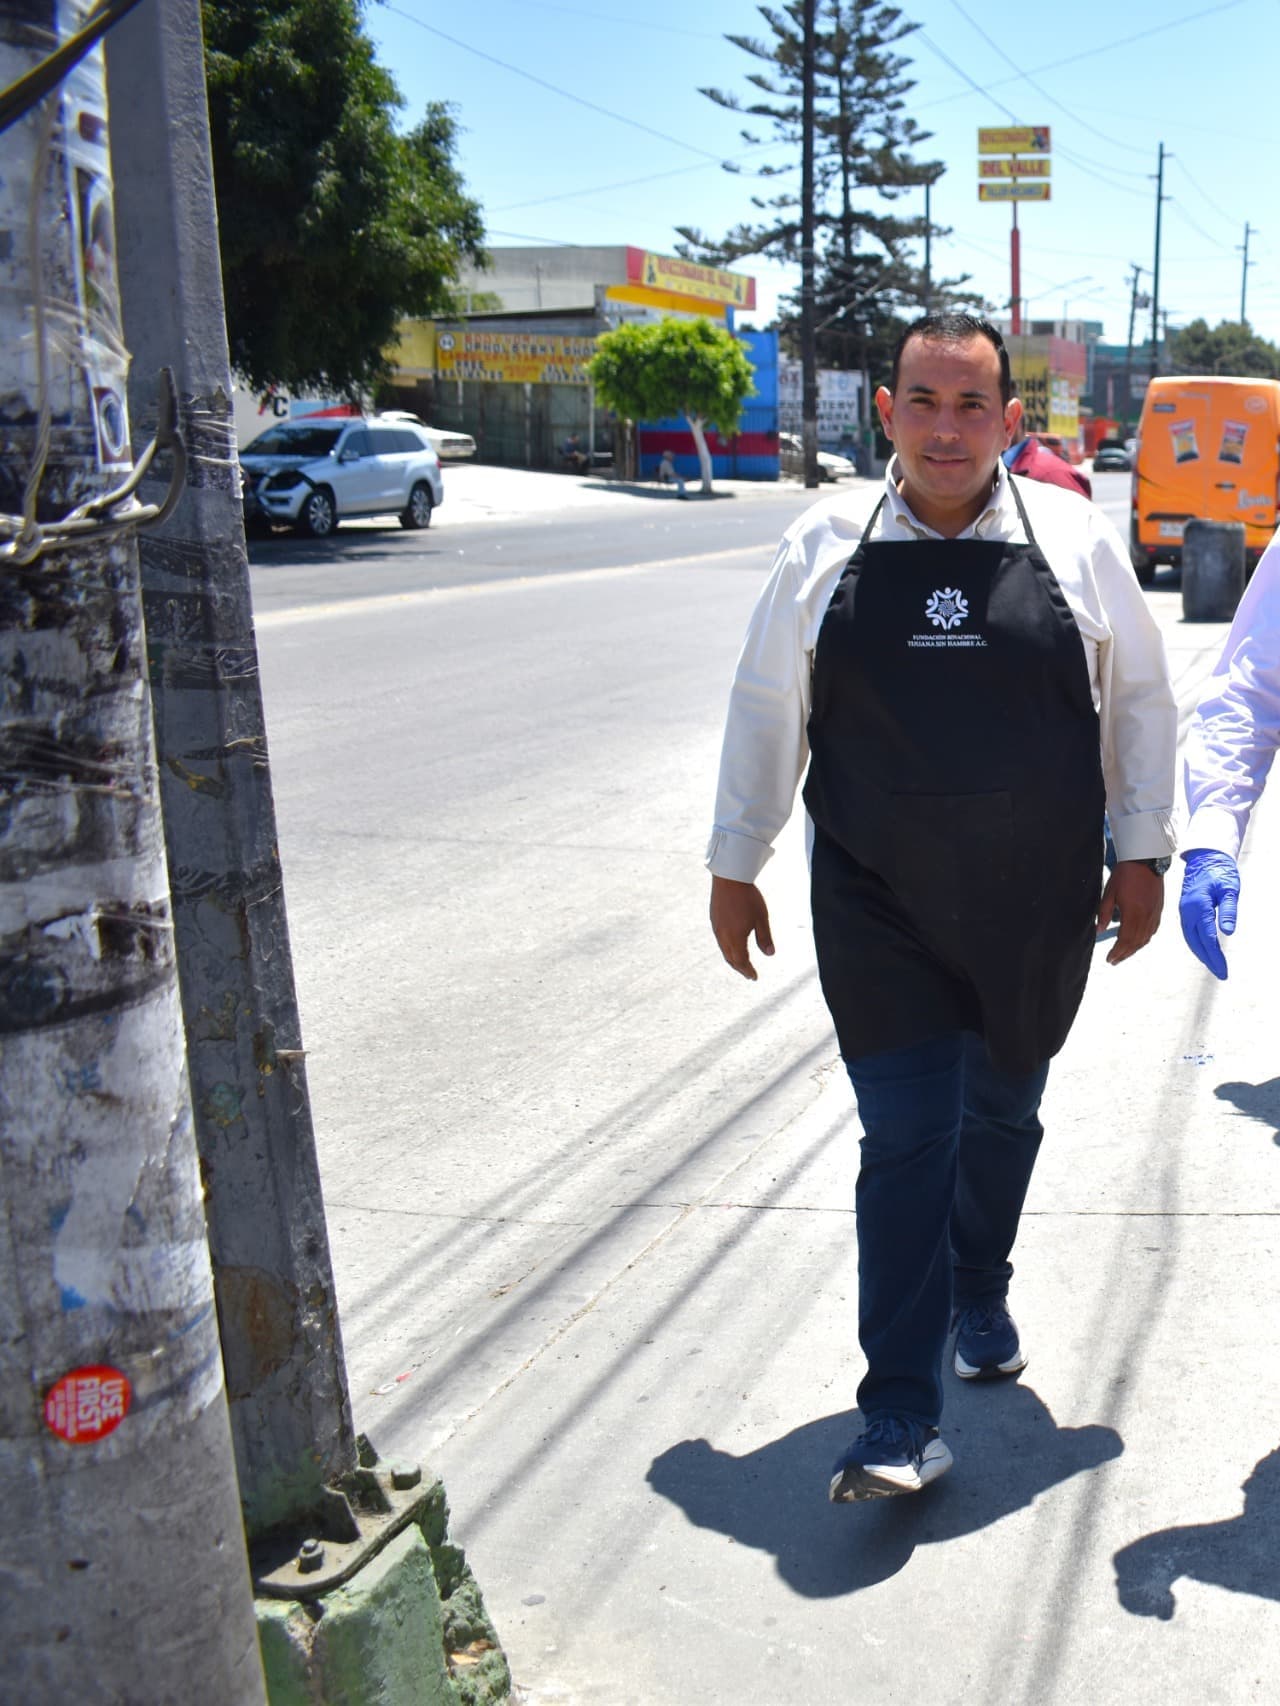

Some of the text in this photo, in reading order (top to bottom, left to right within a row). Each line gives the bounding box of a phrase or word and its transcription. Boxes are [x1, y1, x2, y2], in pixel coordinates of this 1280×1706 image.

[1008, 160, 1044, 176] VALLE
[78, 1377, 101, 1431] FIRST
[101, 1379, 124, 1421] USE
